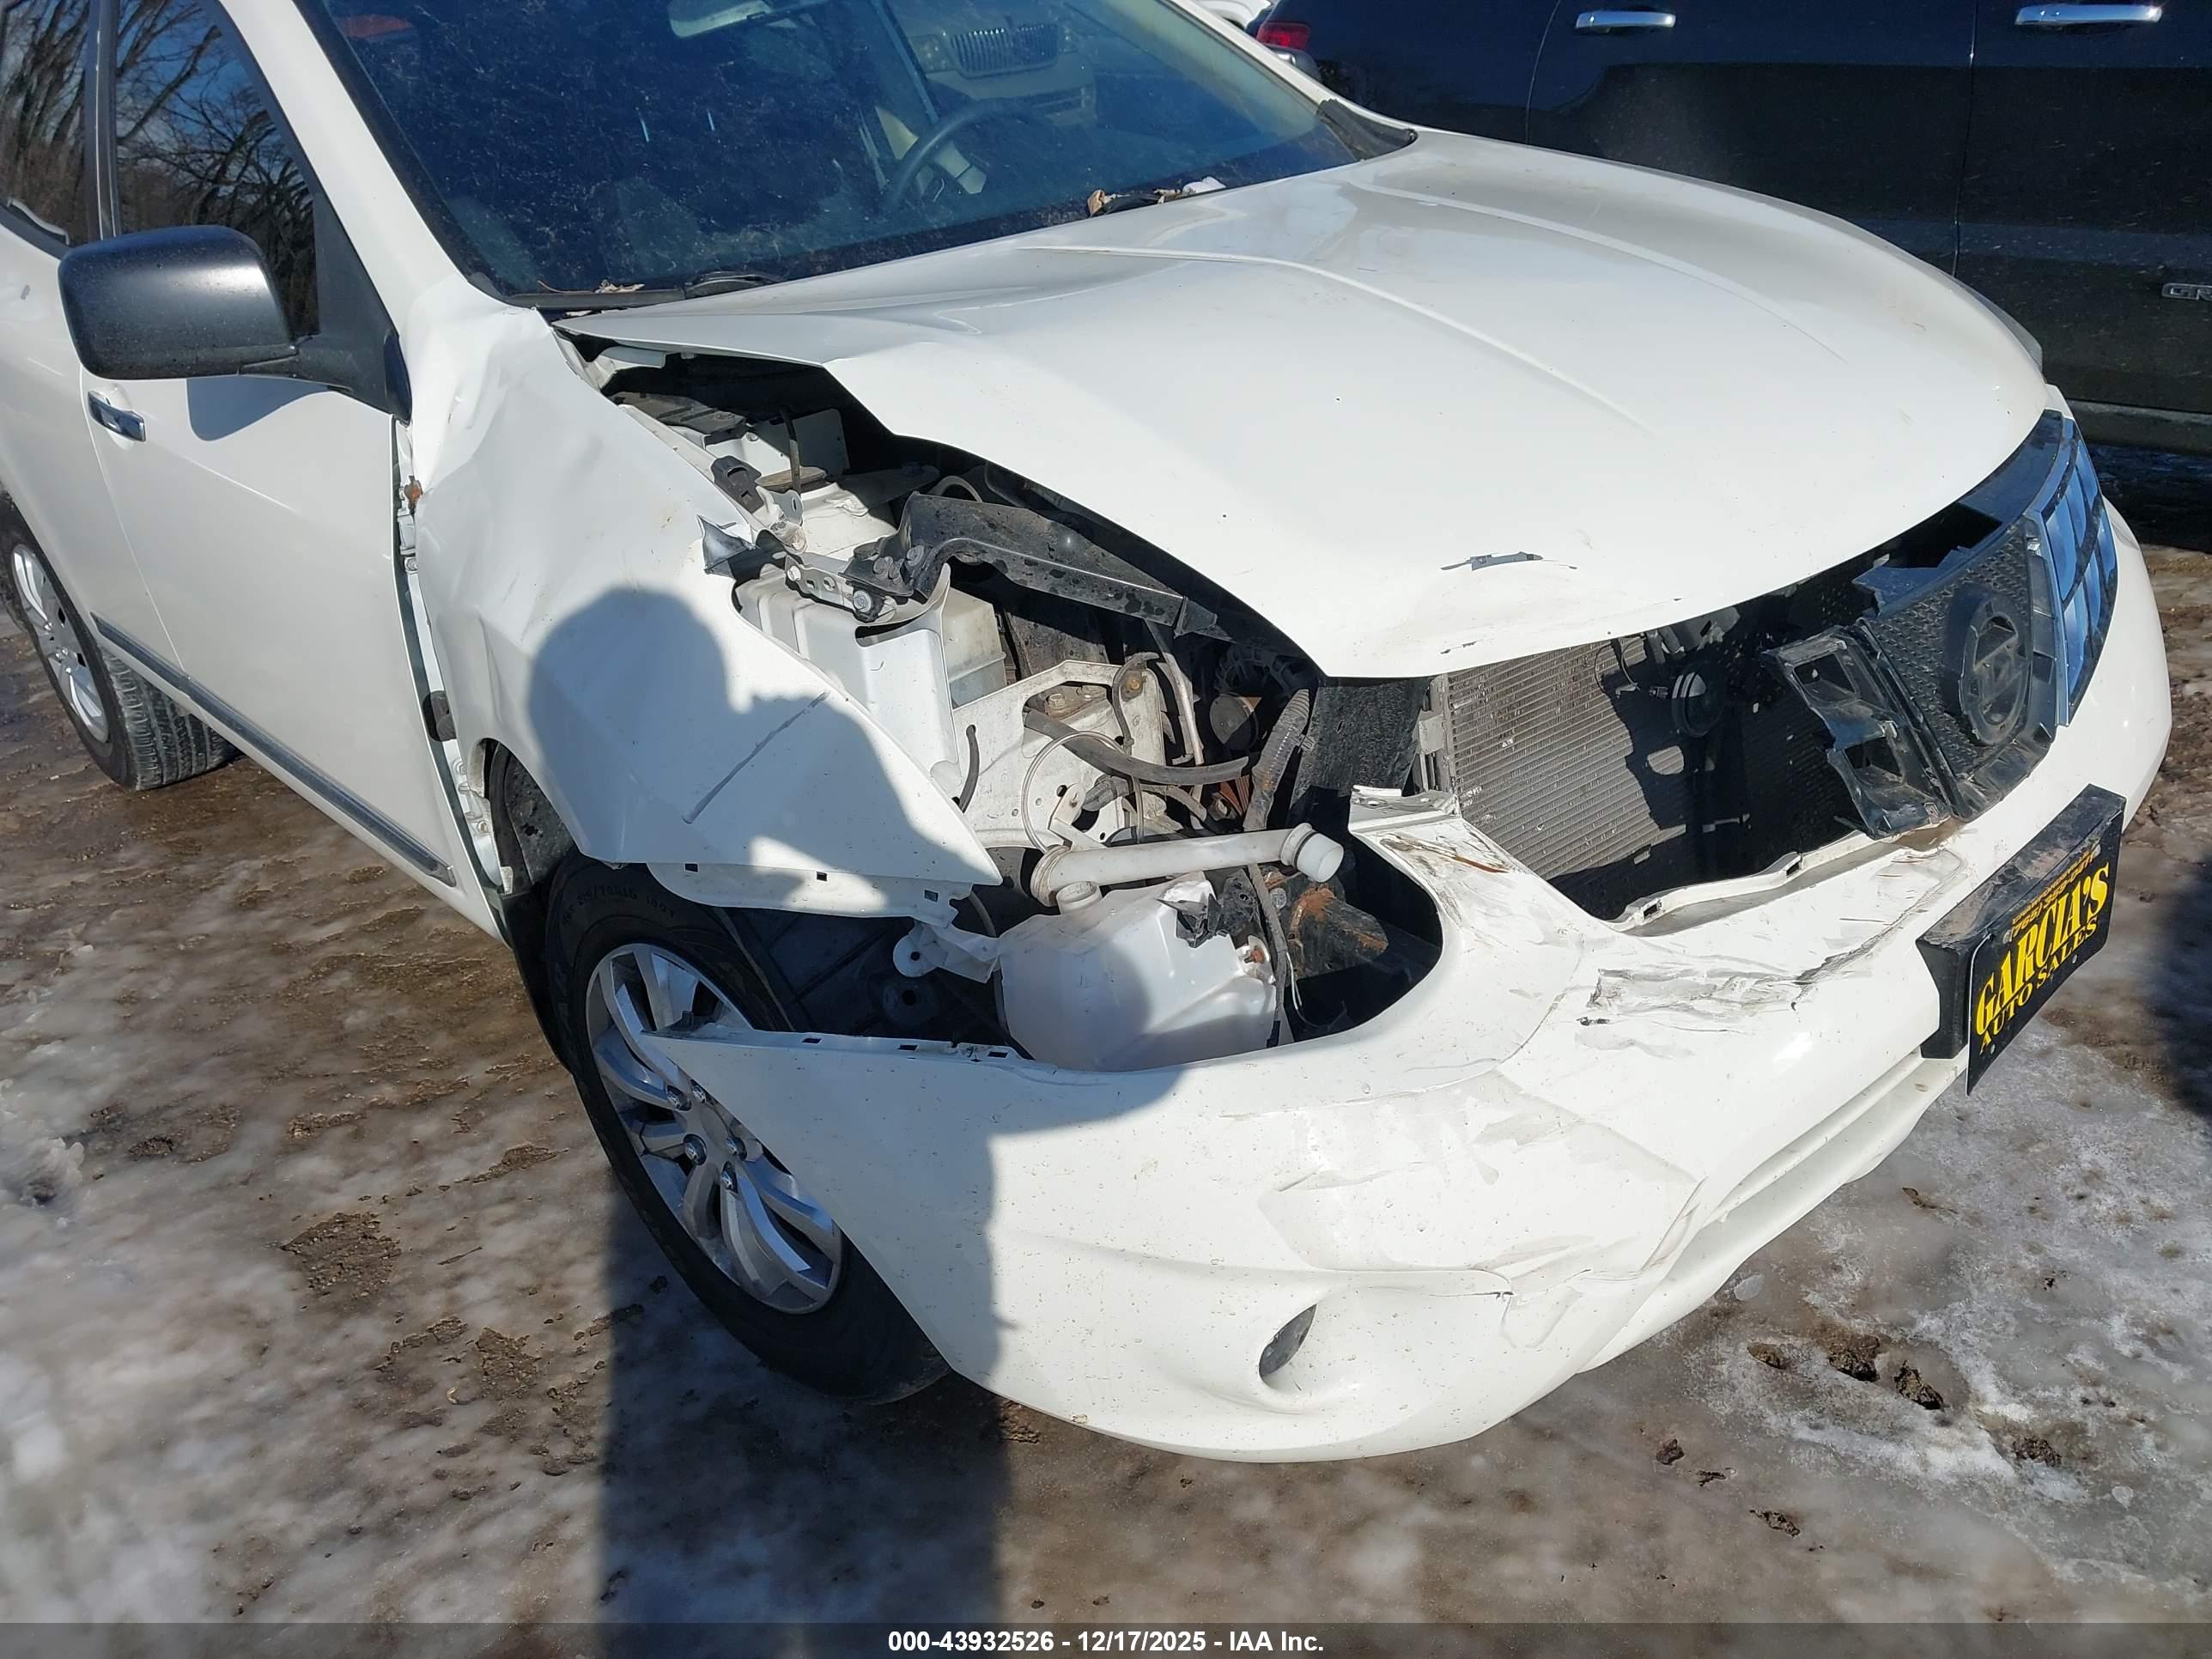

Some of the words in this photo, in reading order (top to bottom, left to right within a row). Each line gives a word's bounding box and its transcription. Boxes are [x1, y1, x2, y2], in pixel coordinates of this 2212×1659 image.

[1977, 861, 2110, 1036] GARCIA'S
[1978, 982, 2033, 1055] AUTO
[2036, 915, 2098, 988] SALES
